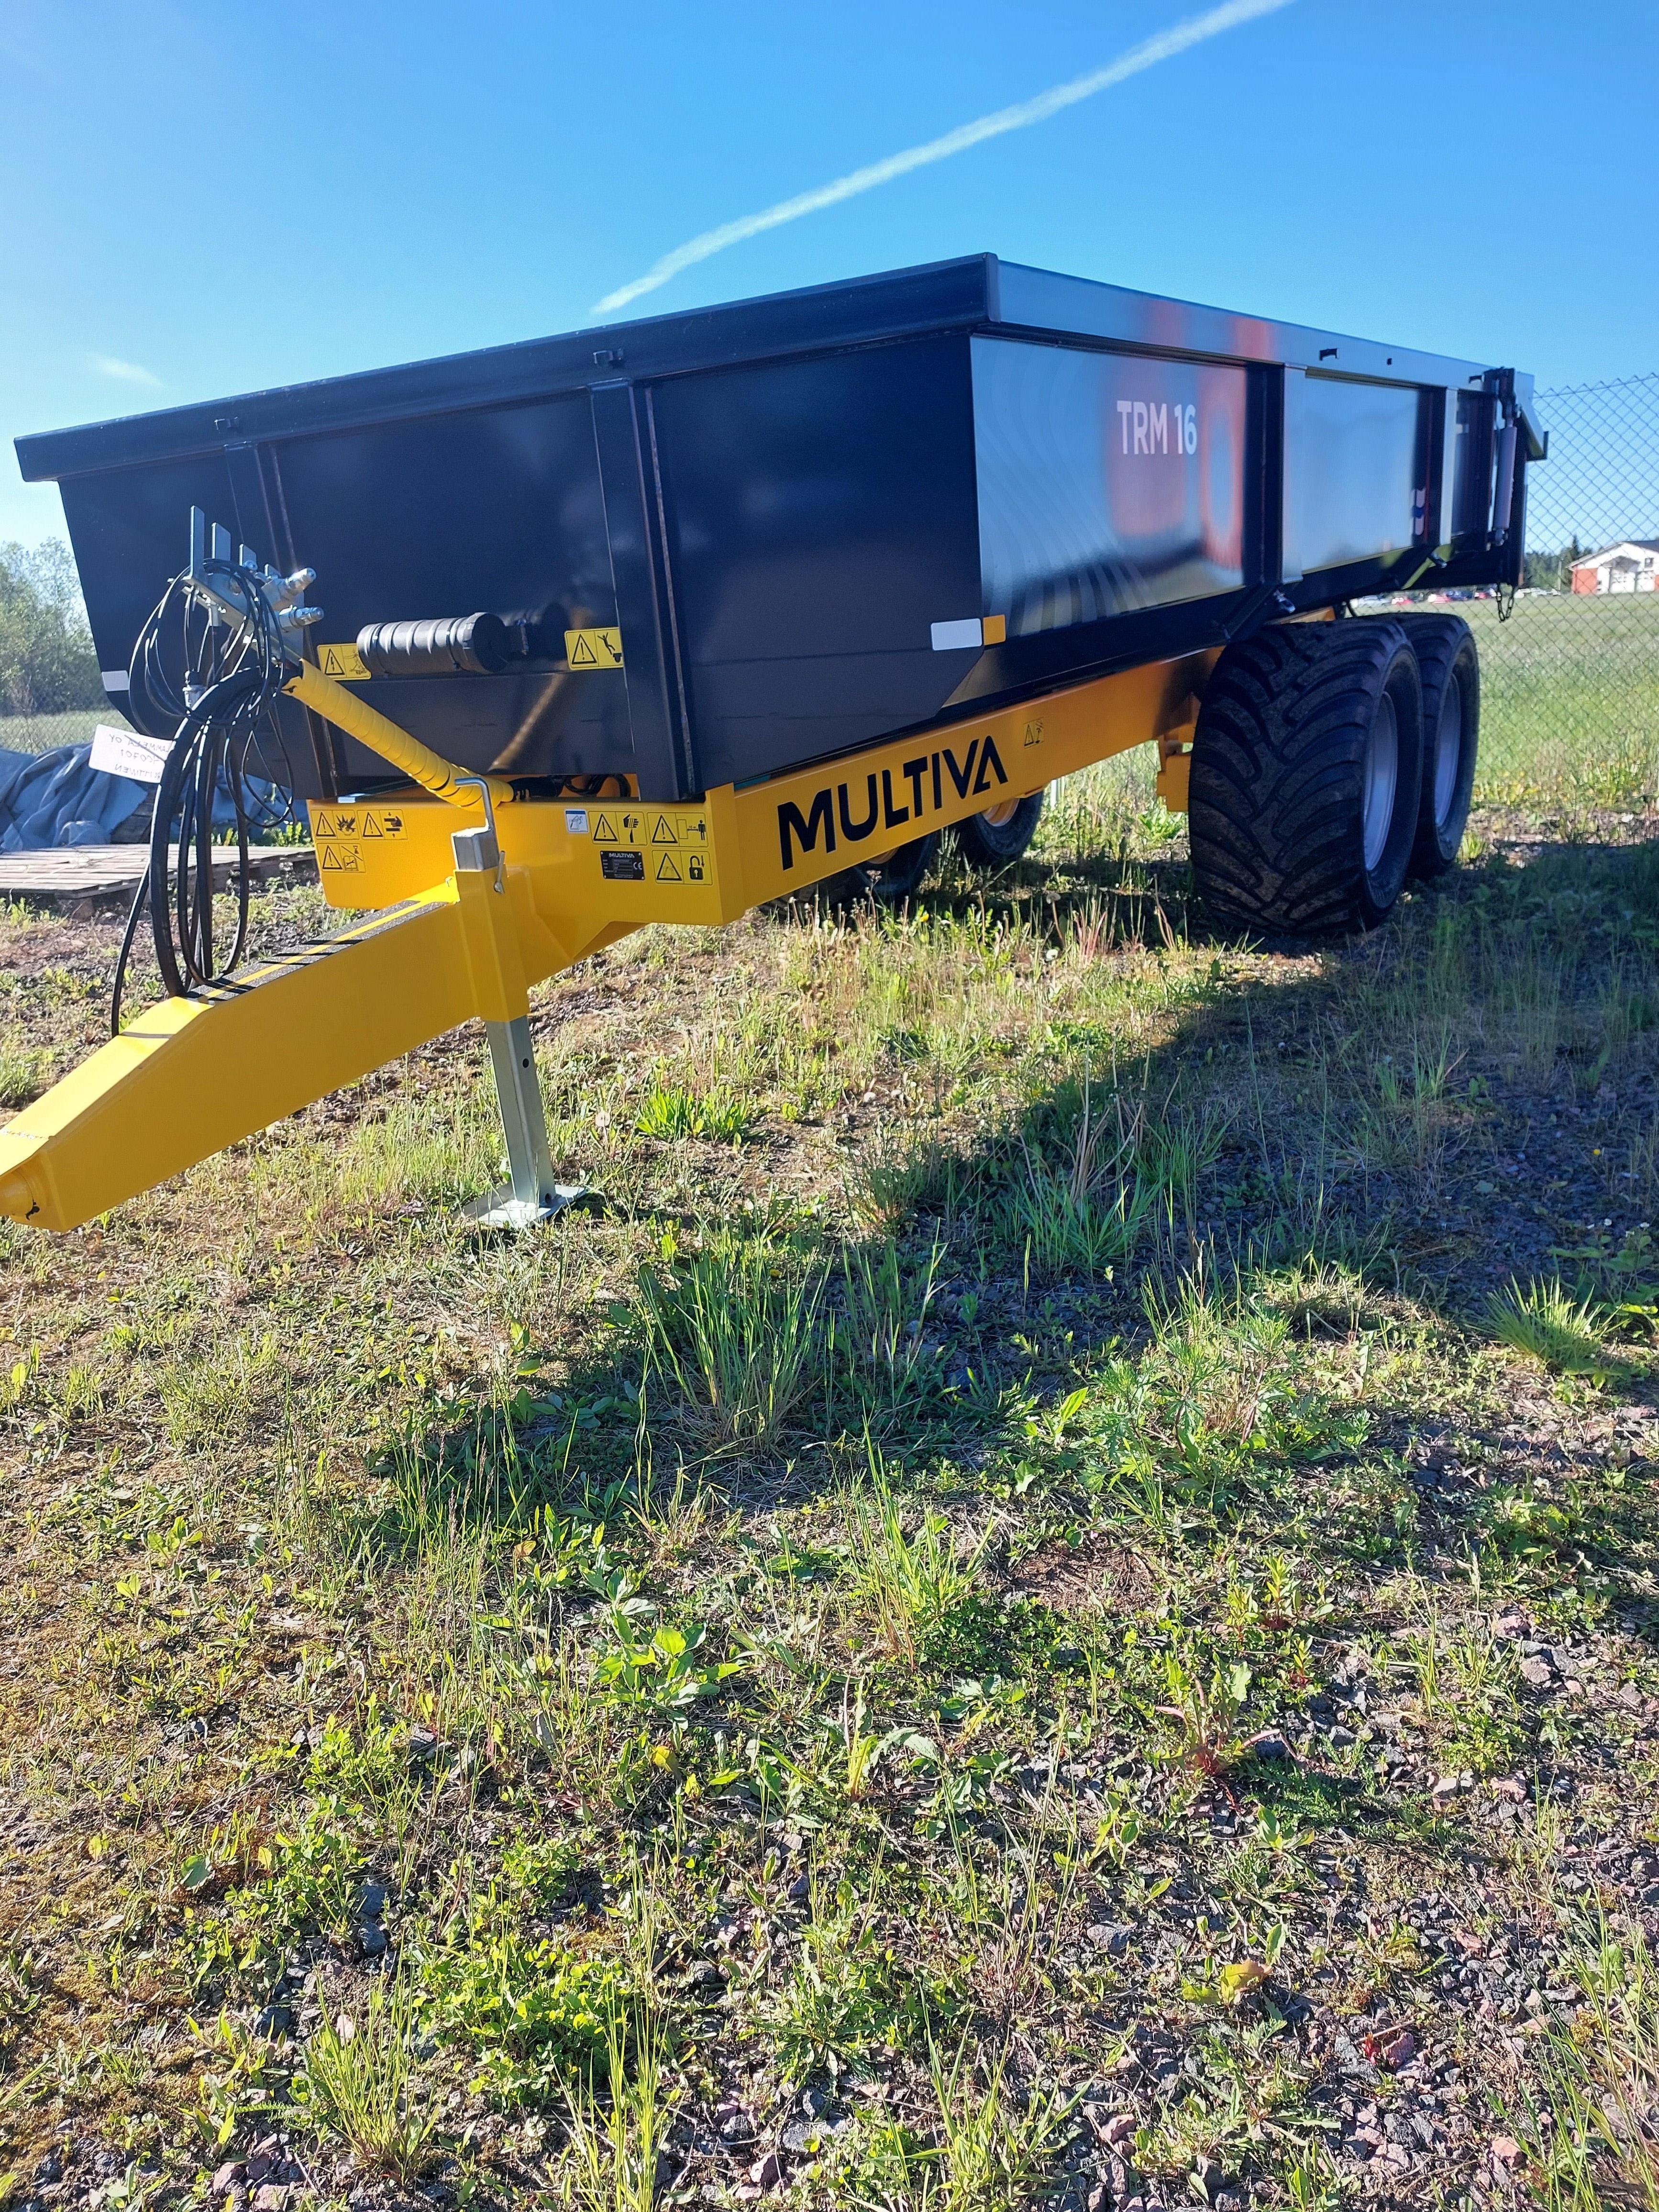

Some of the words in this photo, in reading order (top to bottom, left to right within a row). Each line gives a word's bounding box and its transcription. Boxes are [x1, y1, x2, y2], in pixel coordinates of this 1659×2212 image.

[1117, 400, 1168, 454] TRM
[1174, 404, 1197, 455] 16
[777, 735, 1008, 871] MULTIVA
[633, 862, 642, 870] CE
